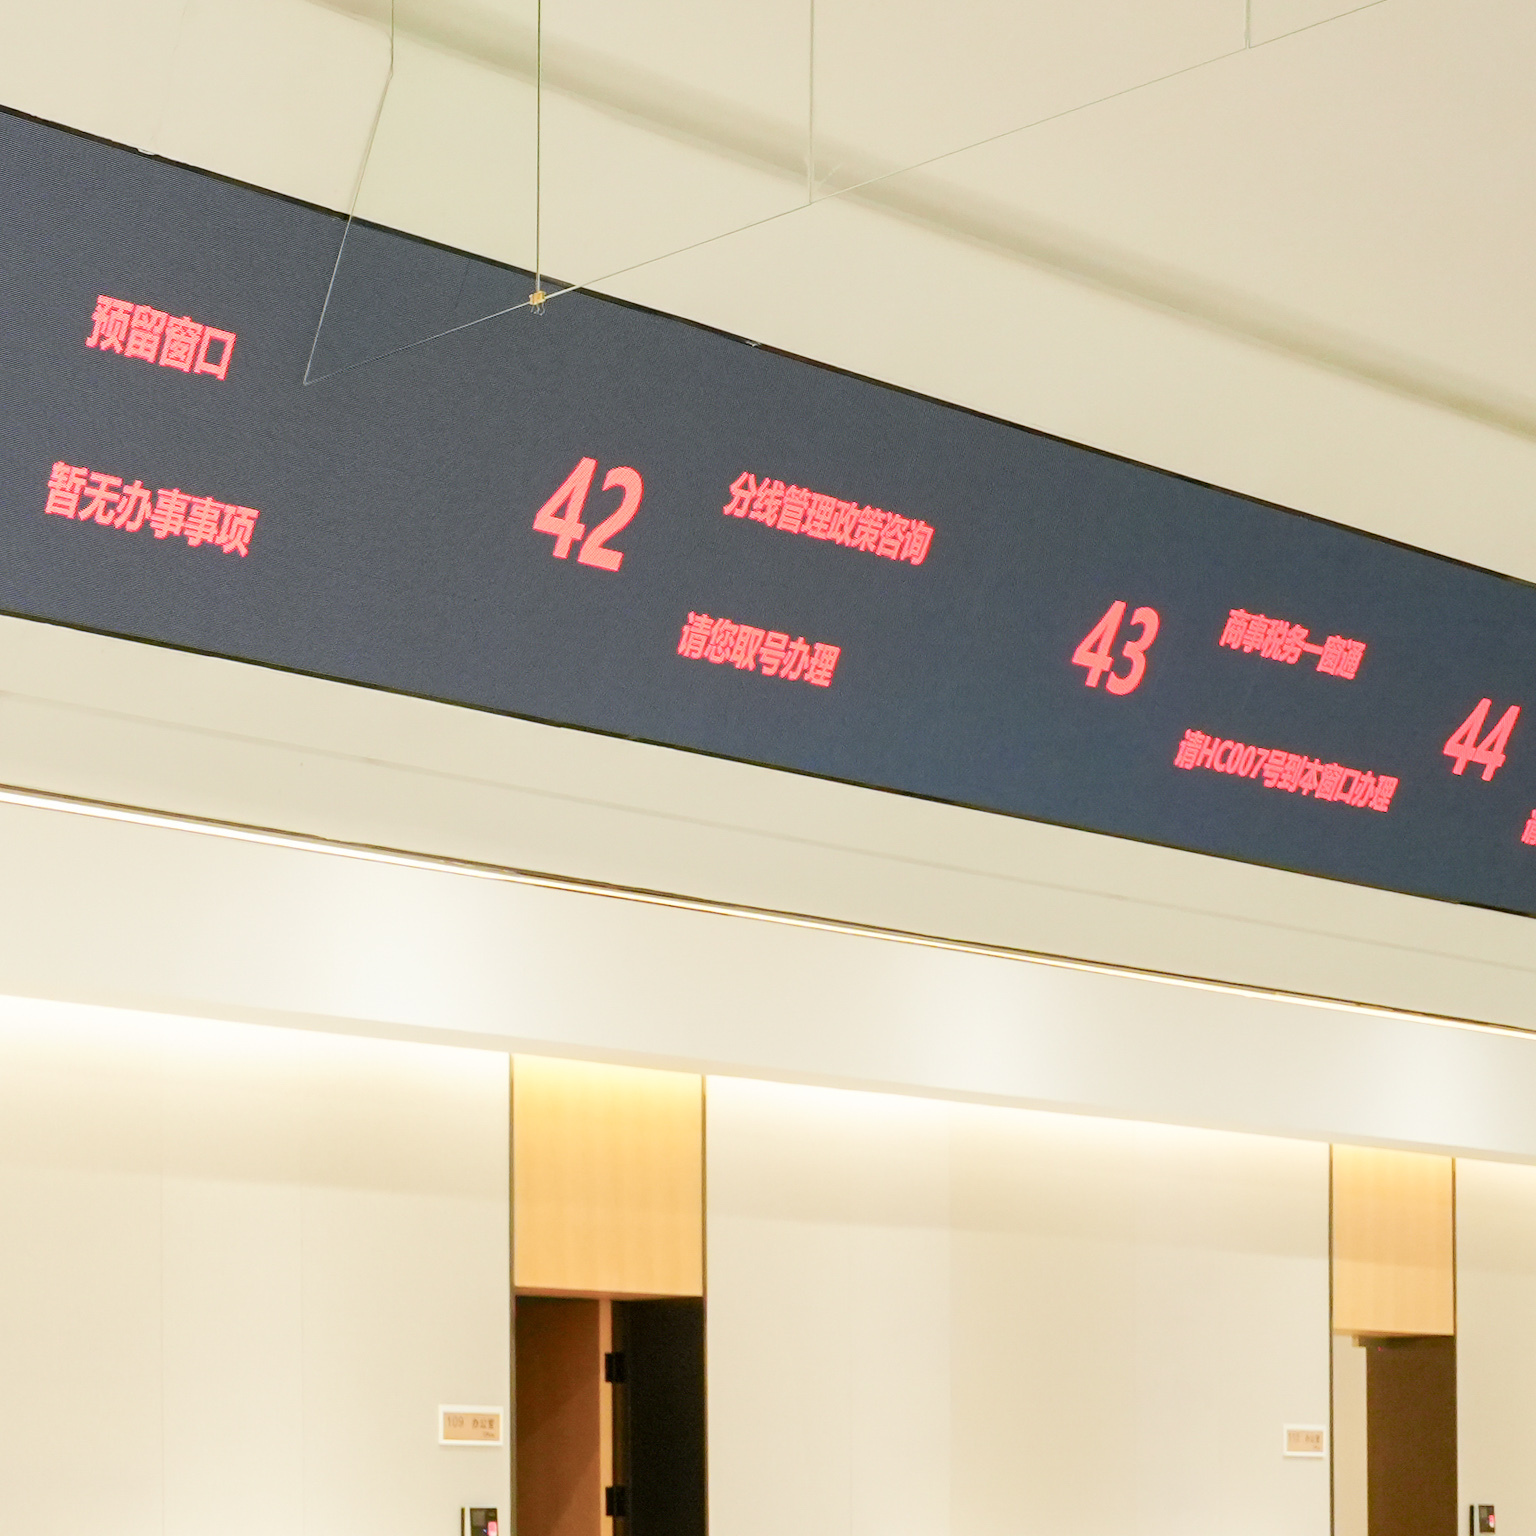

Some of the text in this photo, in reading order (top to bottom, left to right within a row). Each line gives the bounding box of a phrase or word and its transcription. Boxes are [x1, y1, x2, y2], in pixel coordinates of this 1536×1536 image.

[86, 295, 236, 381] 预留窗口
[44, 460, 260, 557] 暂无办事事项
[532, 457, 644, 573] 42
[723, 472, 935, 566] 分线管理政策咨询
[677, 611, 841, 688] 请您取号办理
[1071, 601, 1161, 696] 43
[1219, 609, 1367, 681] 商事税务一窗通
[1173, 729, 1401, 812] 请HC007号到本窗口办理
[1442, 698, 1523, 782] 44
